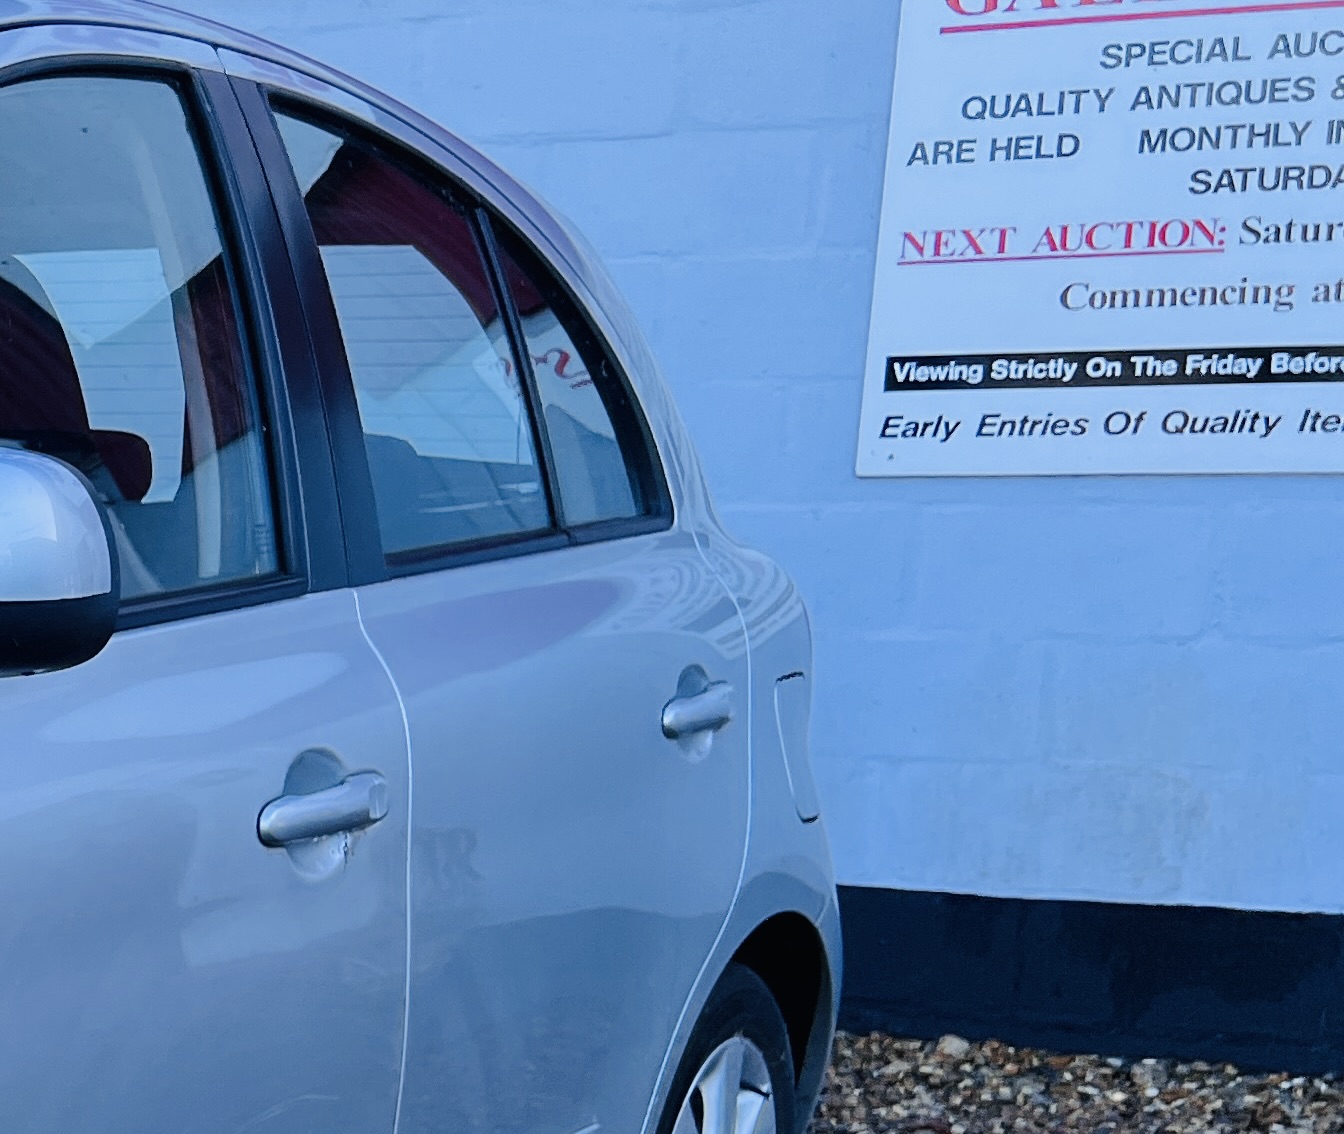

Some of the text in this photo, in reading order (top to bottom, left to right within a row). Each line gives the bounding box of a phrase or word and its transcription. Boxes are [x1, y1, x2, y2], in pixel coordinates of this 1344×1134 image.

[1100, 37, 1251, 69] SPECIAL
[961, 87, 1115, 120] QUALITY
[1130, 77, 1315, 111] ANTIQUES
[907, 140, 976, 166] ARE
[990, 133, 1080, 161] HELD
[1139, 121, 1311, 153] MONTHLY
[900, 217, 1226, 257] NEXT AUCTION:
[1060, 278, 1295, 311] Commencing
[894, 361, 983, 384] Viewing
[991, 358, 1078, 382] Strictly
[1086, 357, 1121, 377] On
[1130, 356, 1177, 376] The
[1185, 354, 1264, 378] Friday
[879, 409, 1344, 443] Early Entries Of Quality Ite
